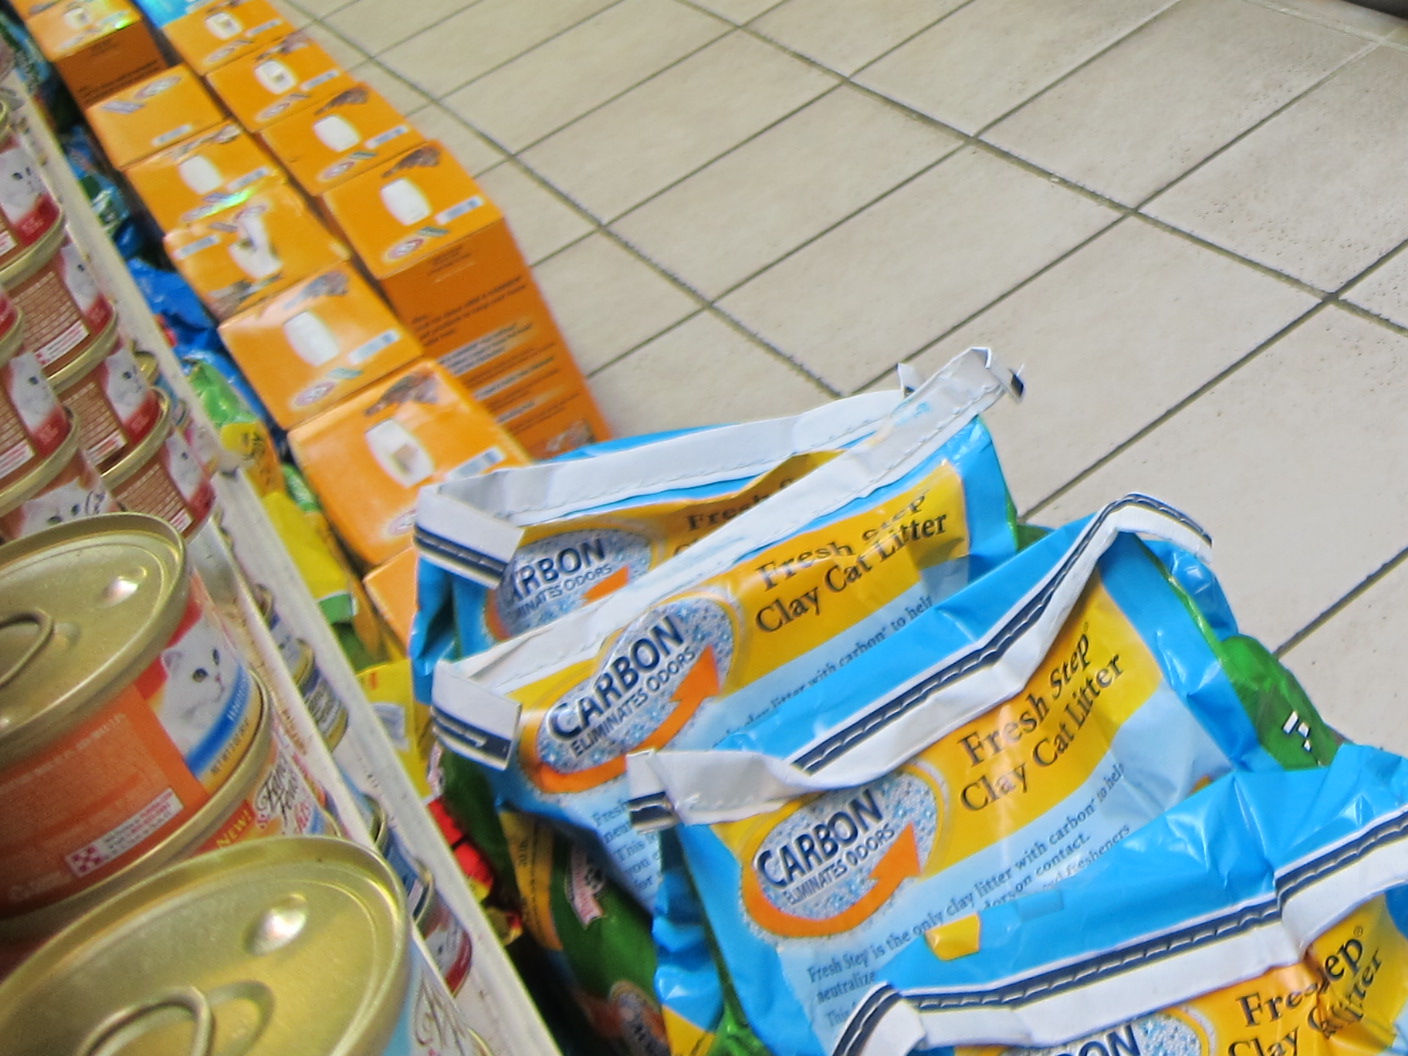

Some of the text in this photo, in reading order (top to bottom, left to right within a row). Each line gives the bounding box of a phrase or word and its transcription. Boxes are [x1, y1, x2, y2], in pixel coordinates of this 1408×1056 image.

[516, 561, 613, 619] INATES ODORS
[754, 512, 948, 634] Clay Cat Litter
[755, 540, 856, 593] Fresh
[547, 613, 685, 741] CARBON
[568, 645, 696, 759] ELIMINATES ODORS
[806, 659, 838, 687] with
[890, 616, 907, 633] to
[956, 631, 1091, 769] Fresh Step
[958, 651, 1126, 814] Clay Cat Litter
[216, 809, 254, 848] NEW!
[756, 786, 886, 888] CARBON
[786, 821, 897, 907] ELIMINATES ODORS
[1063, 822, 1133, 880] Fresheners
[806, 958, 844, 986] Fresh
[842, 948, 872, 975] Step
[872, 942, 887, 961] is
[886, 932, 913, 955] the
[911, 907, 945, 941] only
[944, 891, 977, 921] clay
[975, 870, 1012, 903] litter
[1013, 842, 1049, 875] with
[1047, 801, 1097, 848] carbon
[1094, 784, 1110, 805] to
[815, 832, 1093, 1006] neutralize dors on contact.
[1236, 933, 1365, 1029] Fre ep
